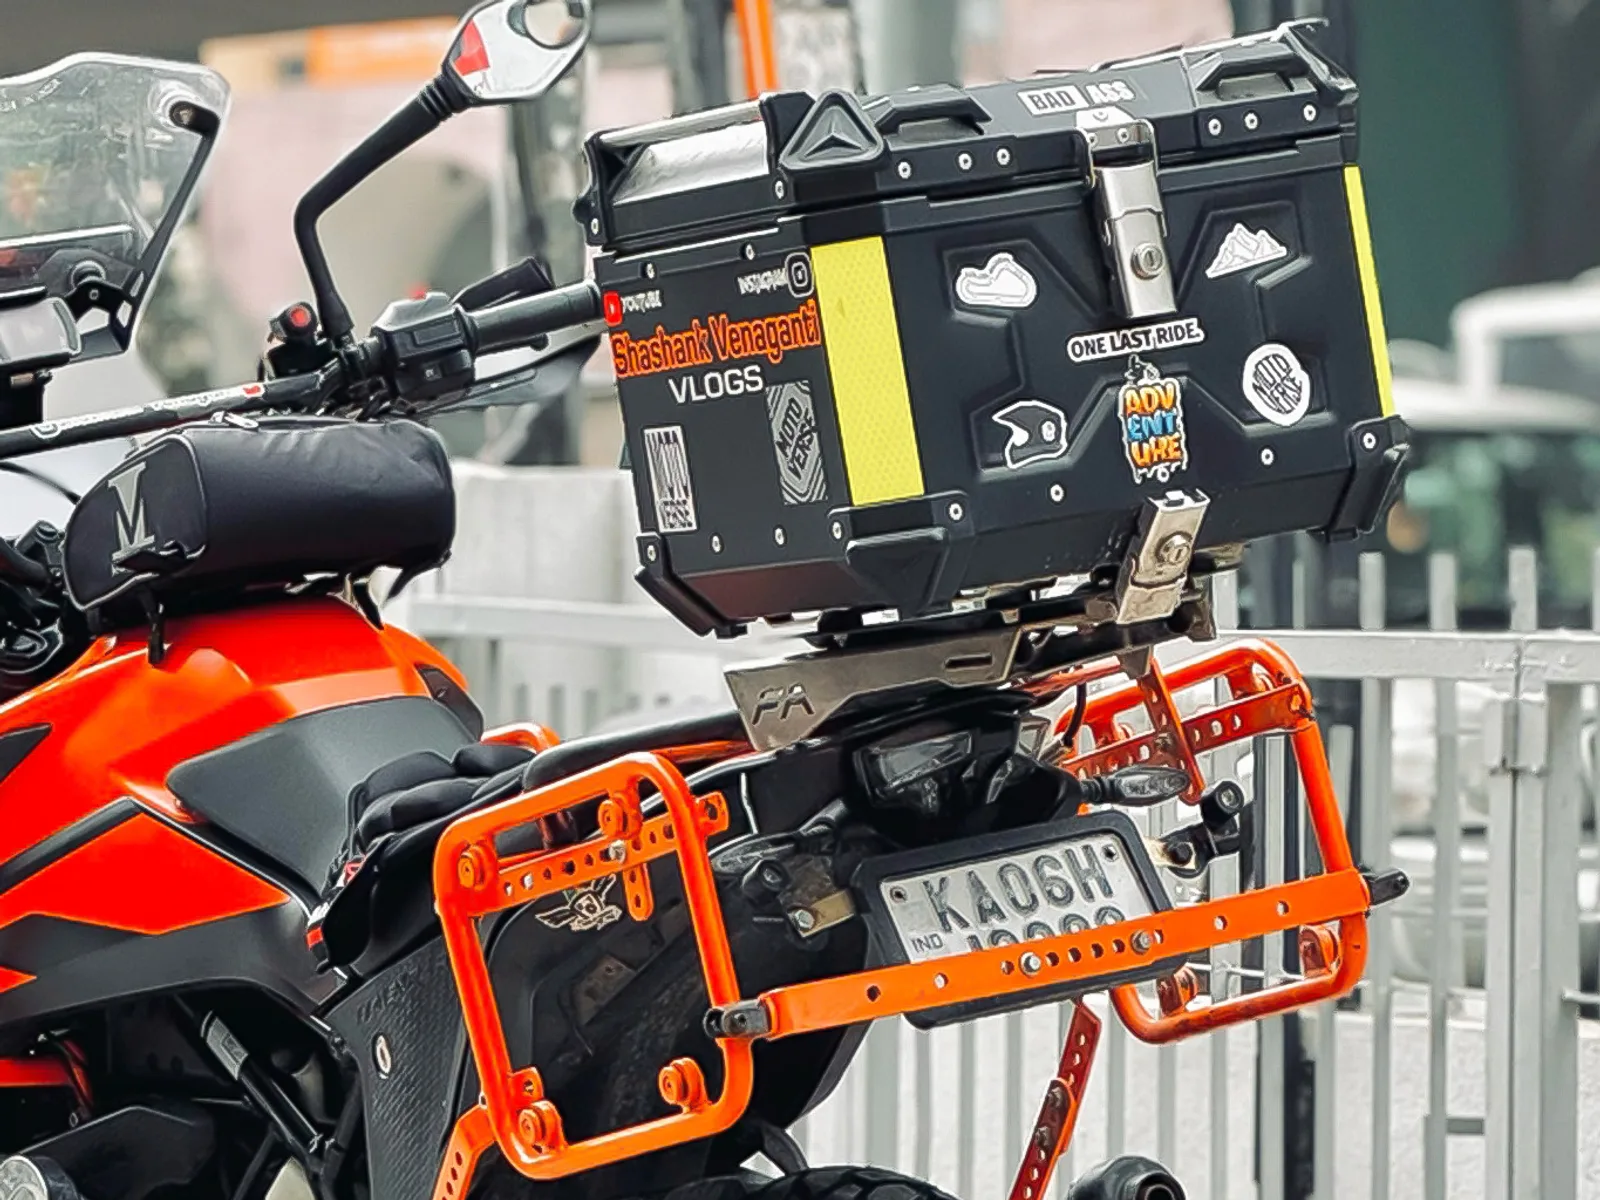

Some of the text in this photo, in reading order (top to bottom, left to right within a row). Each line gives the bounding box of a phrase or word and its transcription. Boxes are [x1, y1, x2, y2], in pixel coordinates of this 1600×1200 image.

[1027, 80, 1135, 110] BAD ASS
[611, 298, 821, 377] Shashank Venaganti
[1071, 337, 1108, 358] ONE
[1110, 329, 1152, 351] LAST
[668, 365, 764, 404] VLOGS
[922, 844, 1114, 934] KA06H
[911, 932, 944, 953] IND
